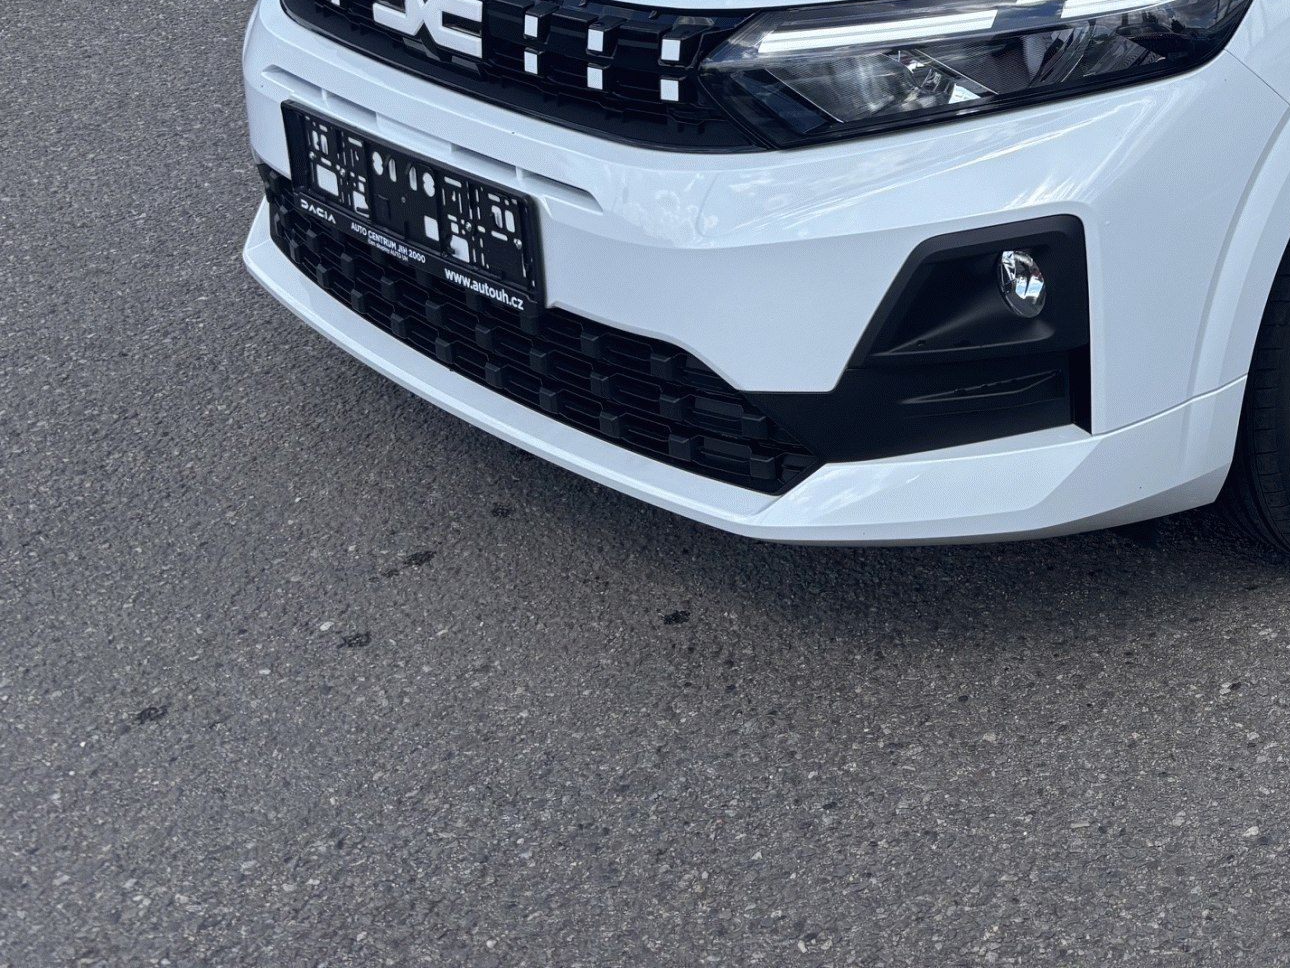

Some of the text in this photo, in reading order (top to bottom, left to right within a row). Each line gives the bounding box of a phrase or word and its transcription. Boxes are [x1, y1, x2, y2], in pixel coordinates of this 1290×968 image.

[300, 198, 336, 225] DACIA
[351, 222, 368, 236] AUTO
[367, 230, 397, 250] CENTRUM
[408, 249, 426, 264] 2000
[444, 267, 525, 311] www.autouh.cz
